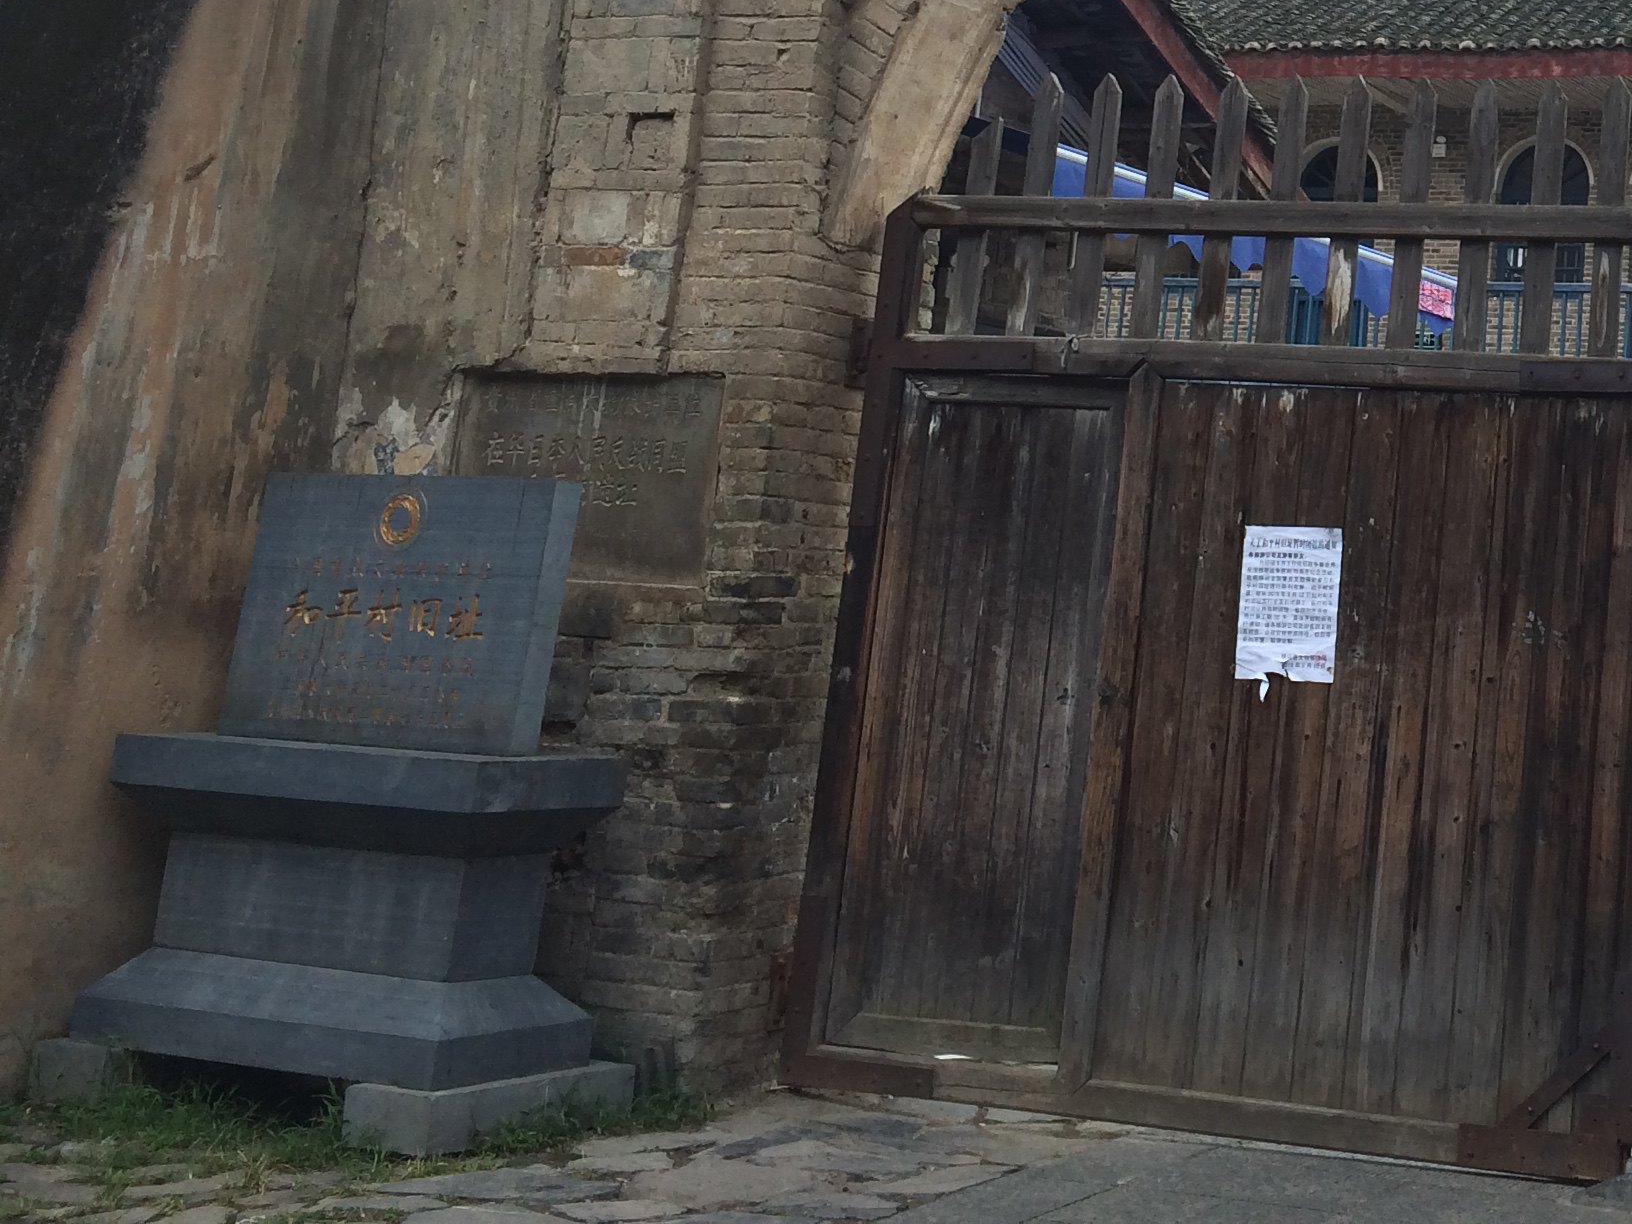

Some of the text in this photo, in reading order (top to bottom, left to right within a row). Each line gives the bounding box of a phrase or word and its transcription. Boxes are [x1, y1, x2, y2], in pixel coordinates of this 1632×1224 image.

[283, 586, 484, 644] 和平村旧址
